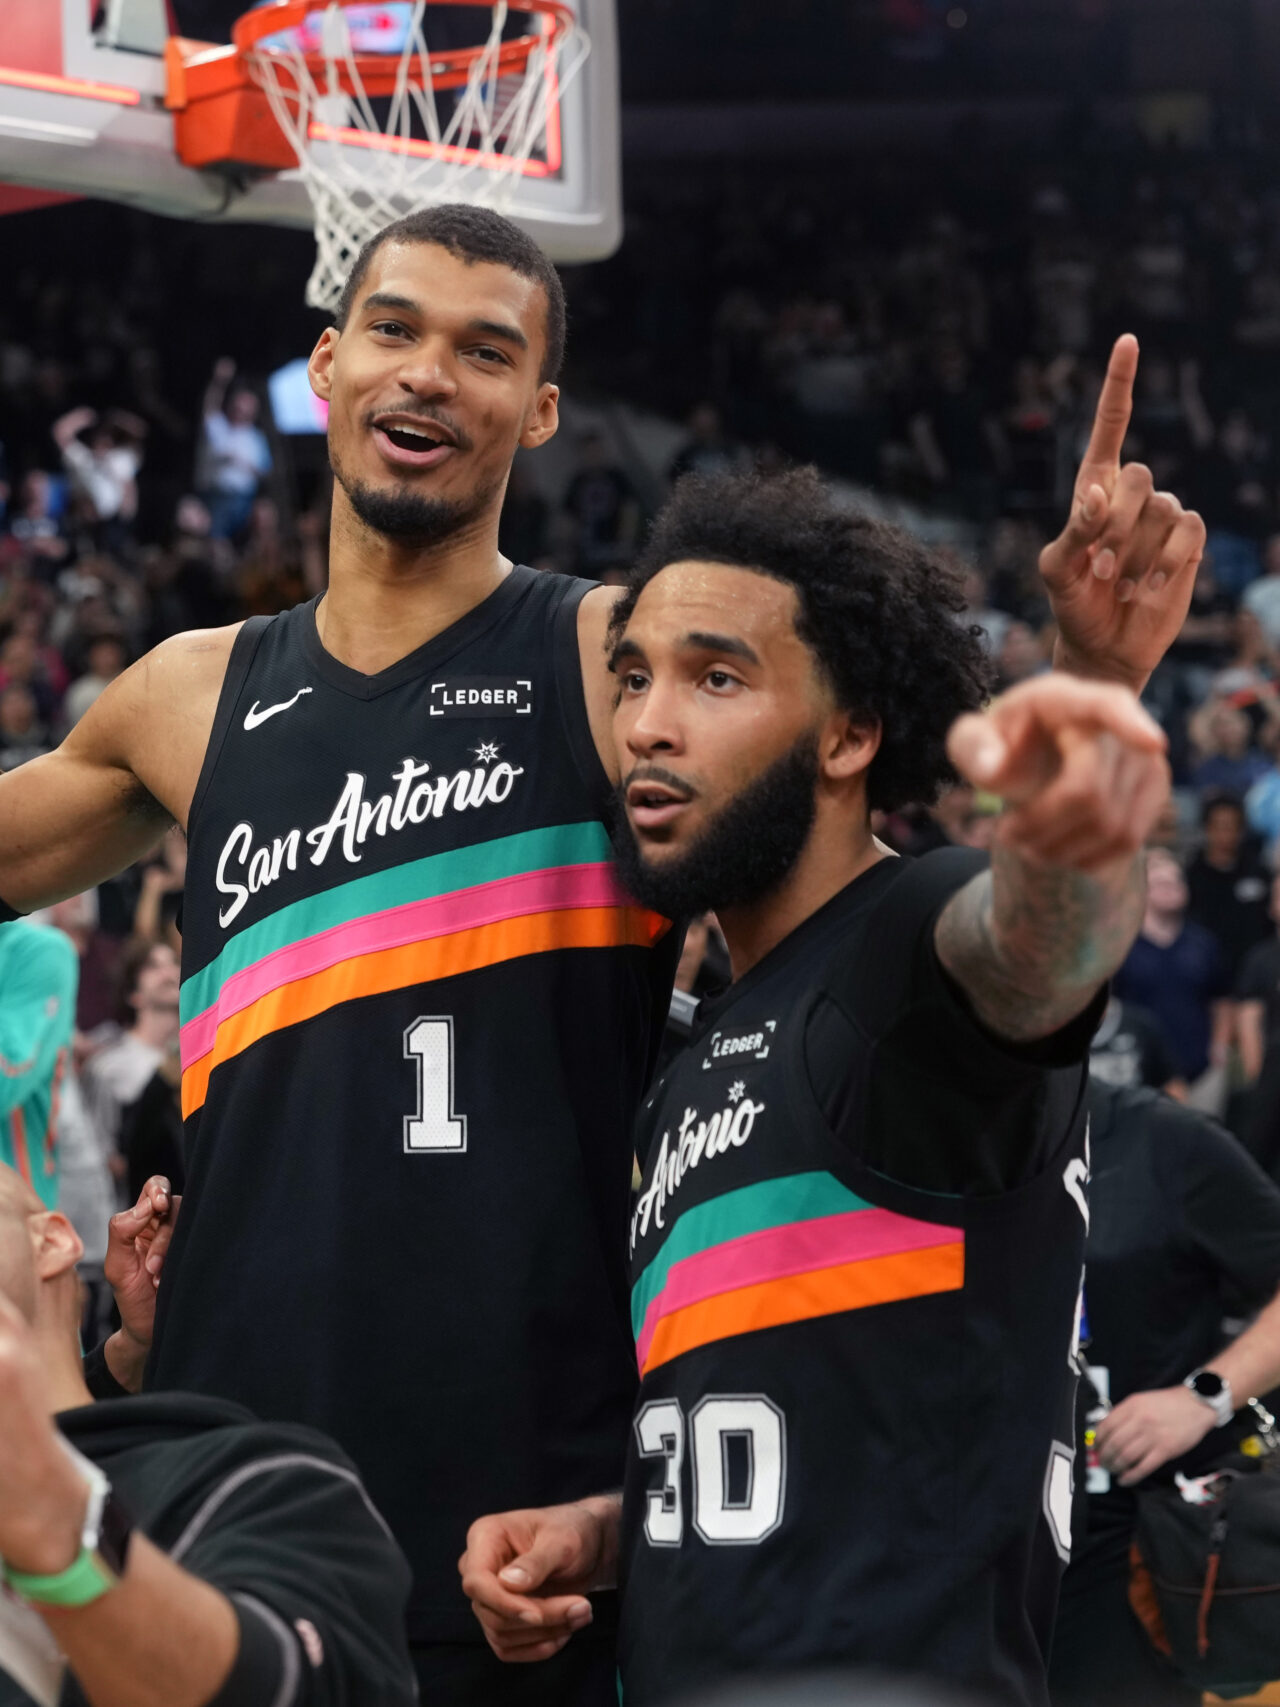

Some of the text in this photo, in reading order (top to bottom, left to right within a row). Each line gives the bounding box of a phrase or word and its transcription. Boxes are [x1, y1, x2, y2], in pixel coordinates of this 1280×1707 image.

[442, 689, 519, 706] LEDGER
[215, 741, 524, 929] San Antonio
[403, 1015, 467, 1153] 1
[712, 1032, 764, 1058] LEDGER
[636, 1080, 766, 1238] Antonio
[632, 1393, 788, 1548] 30
